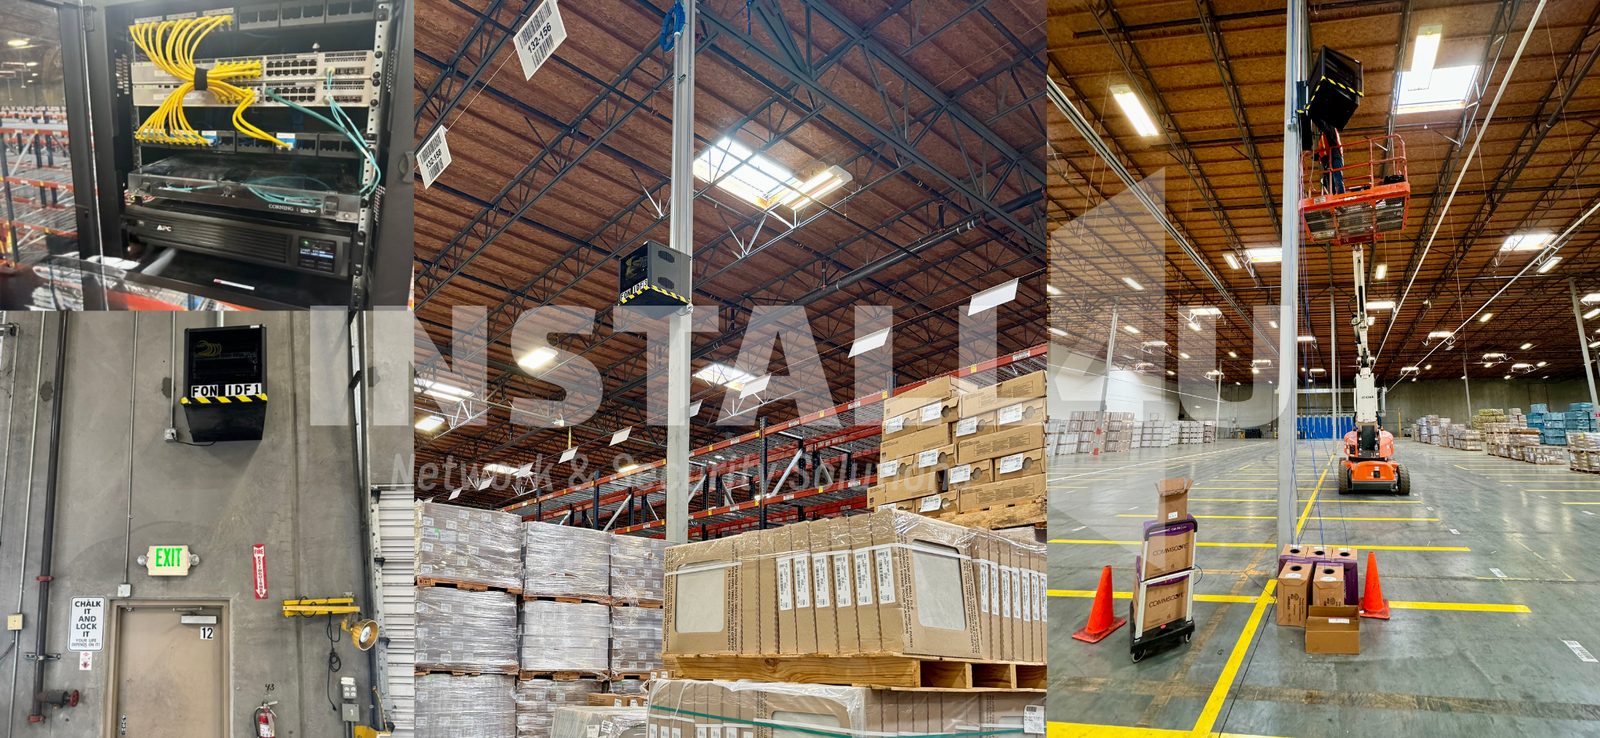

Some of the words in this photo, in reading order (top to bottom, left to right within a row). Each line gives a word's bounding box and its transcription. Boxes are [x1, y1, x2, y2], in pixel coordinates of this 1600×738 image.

[527, 22, 552, 54] 132-156
[192, 385, 218, 397] FON
[228, 383, 260, 395] IDF1
[155, 547, 182, 567] EXIT
[74, 600, 101, 608] CHALK
[202, 627, 213, 639] 12
